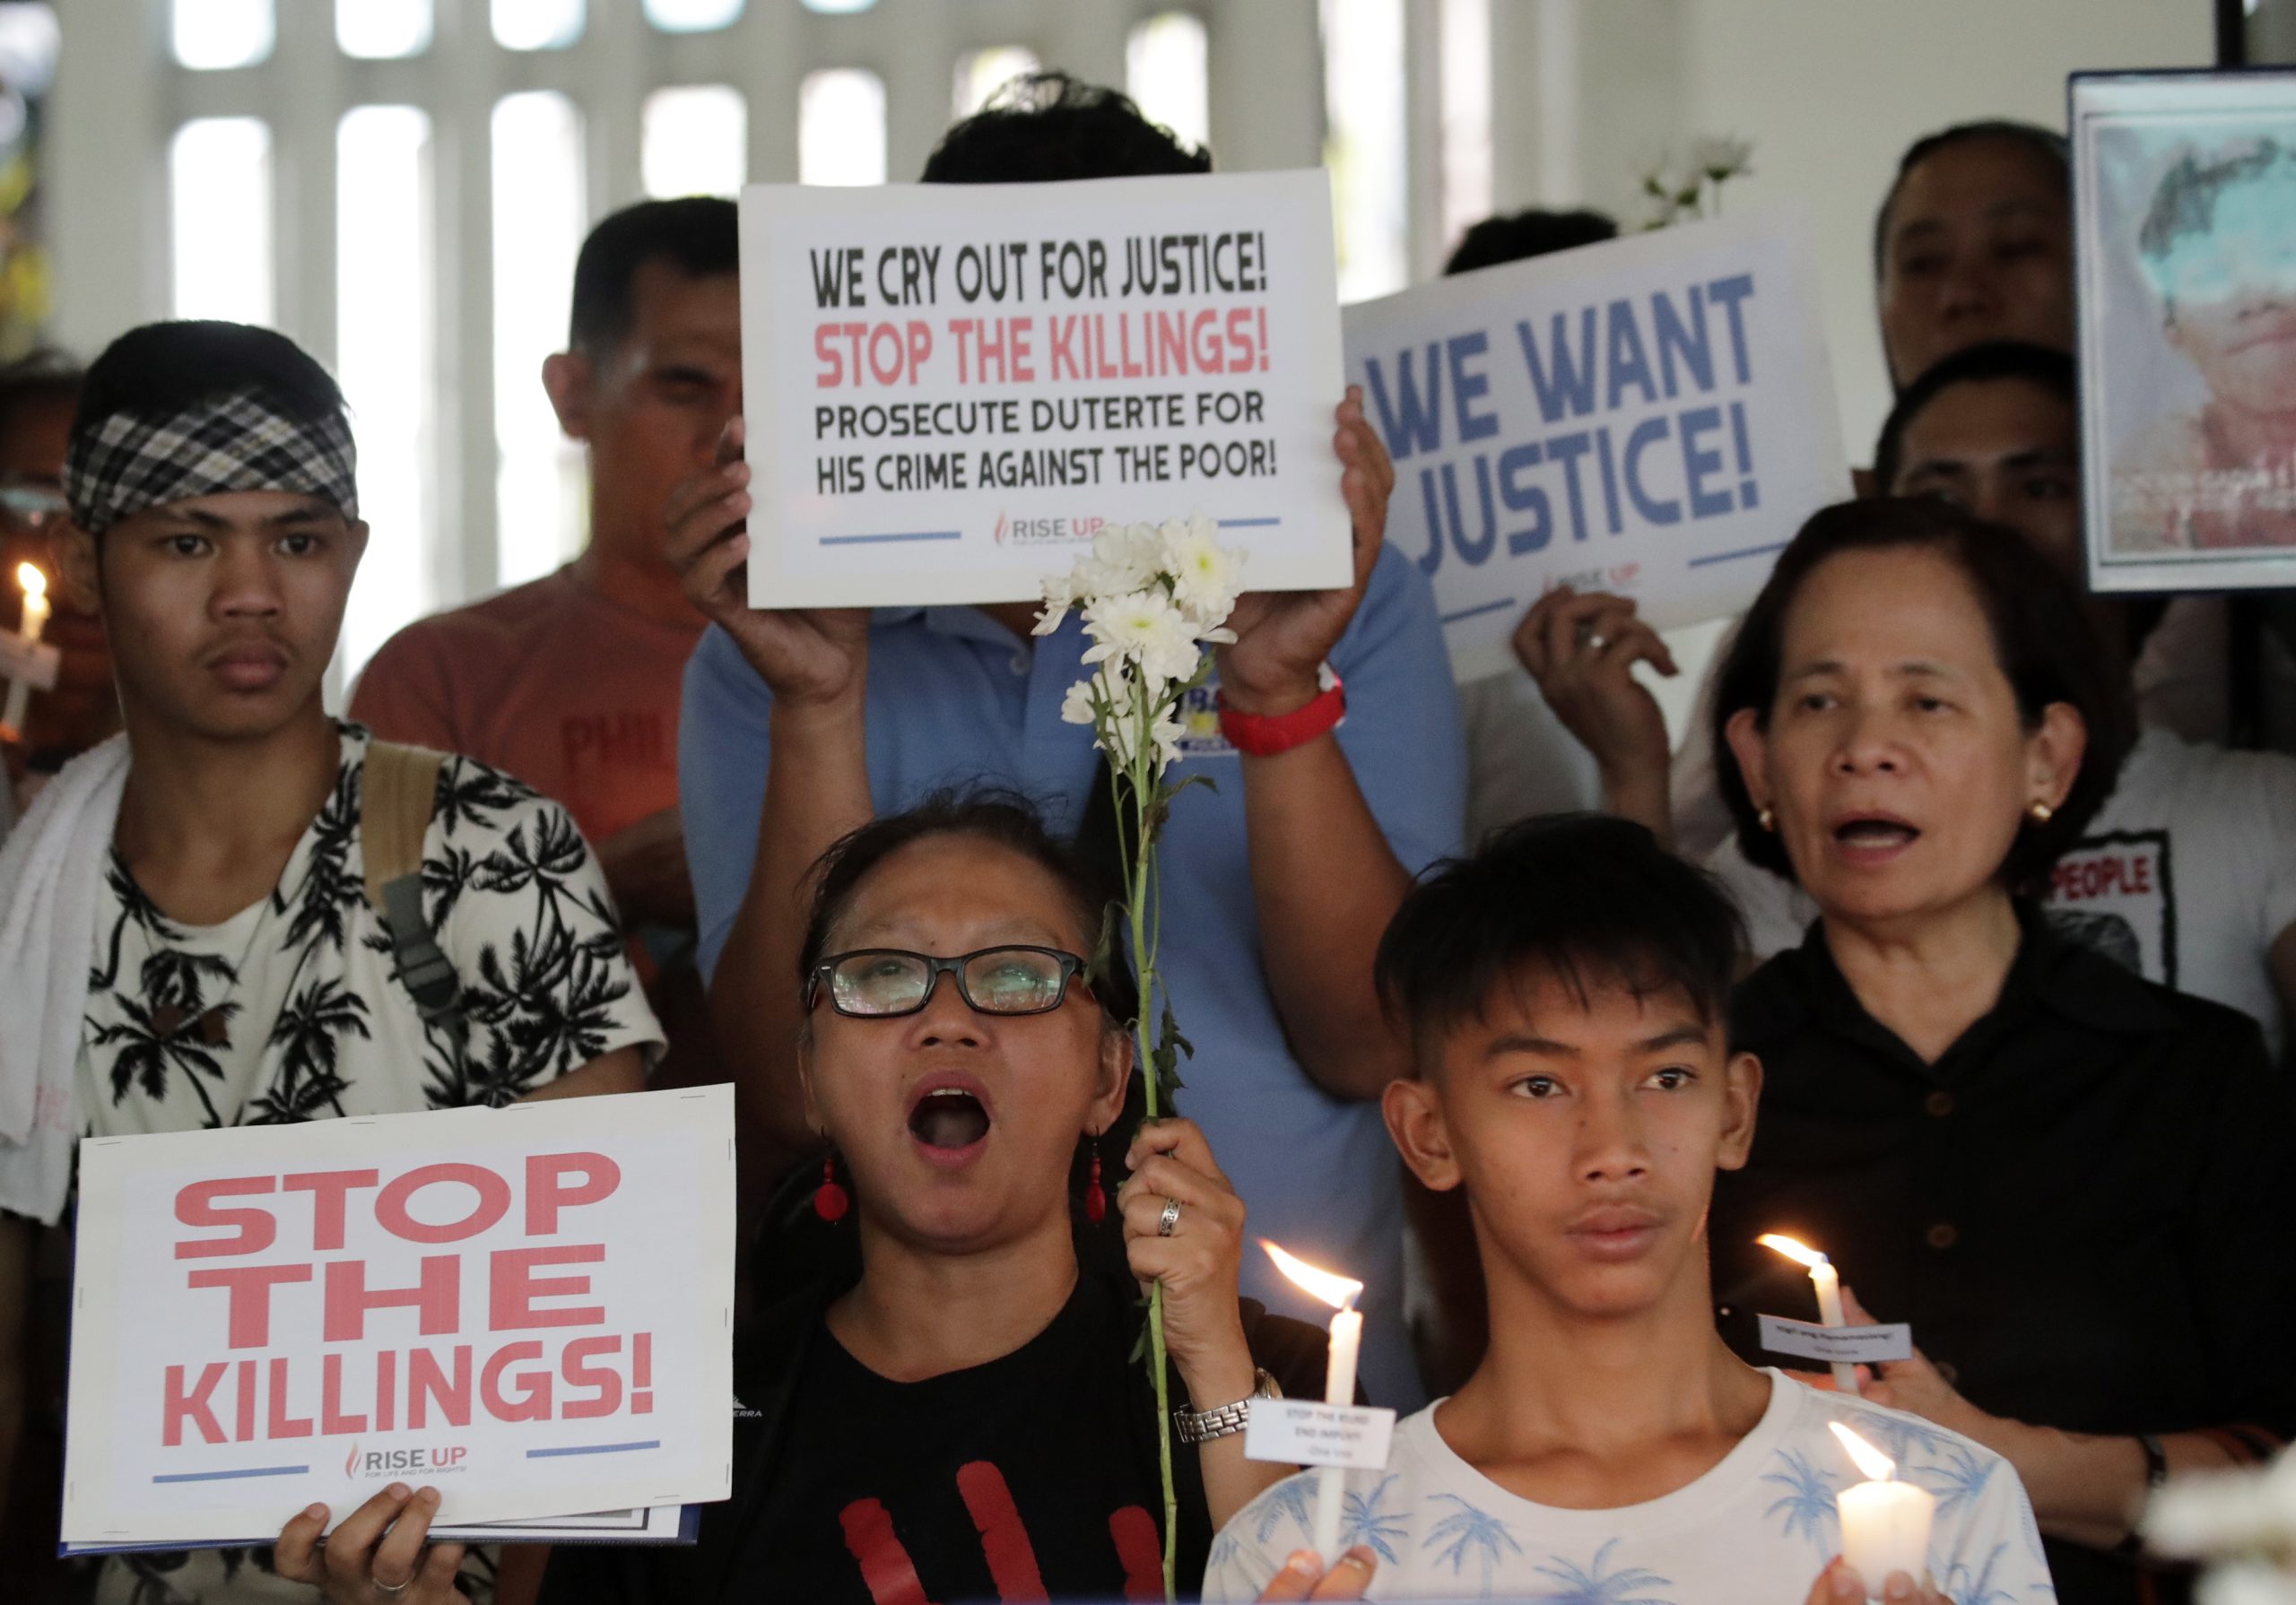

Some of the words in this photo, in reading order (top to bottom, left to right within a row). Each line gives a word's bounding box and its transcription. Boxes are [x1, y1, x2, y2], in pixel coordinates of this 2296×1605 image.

[809, 248, 865, 308] WE
[877, 245, 942, 306] CRY
[954, 242, 1029, 304] OUT
[1040, 238, 1109, 300] FOR
[1120, 231, 1268, 299] JUSTICE!
[814, 320, 933, 389] STOP
[948, 317, 1035, 385] THE
[1048, 307, 1271, 381] KILLINGS!
[1364, 329, 1500, 461] WE
[1516, 273, 1756, 424] WANT
[815, 399, 1020, 440] PROSECUTE
[1032, 393, 1185, 433] DUTERTE
[1196, 390, 1265, 427] FOR
[817, 455, 865, 496] HIS
[875, 451, 969, 493] CRIME
[978, 447, 1103, 490] AGAINST
[1114, 444, 1170, 484] THE
[1179, 439, 1278, 481] POOR!
[1416, 401, 1761, 577] JUSTICE!
[1013, 518, 1066, 538] RISE
[1072, 516, 1105, 536] UP
[173, 1151, 622, 1261] STOP
[187, 1244, 606, 1349] THE
[161, 1332, 654, 1447] KILLINGS!
[366, 1449, 425, 1471] RISE
[431, 1446, 467, 1467] UP
